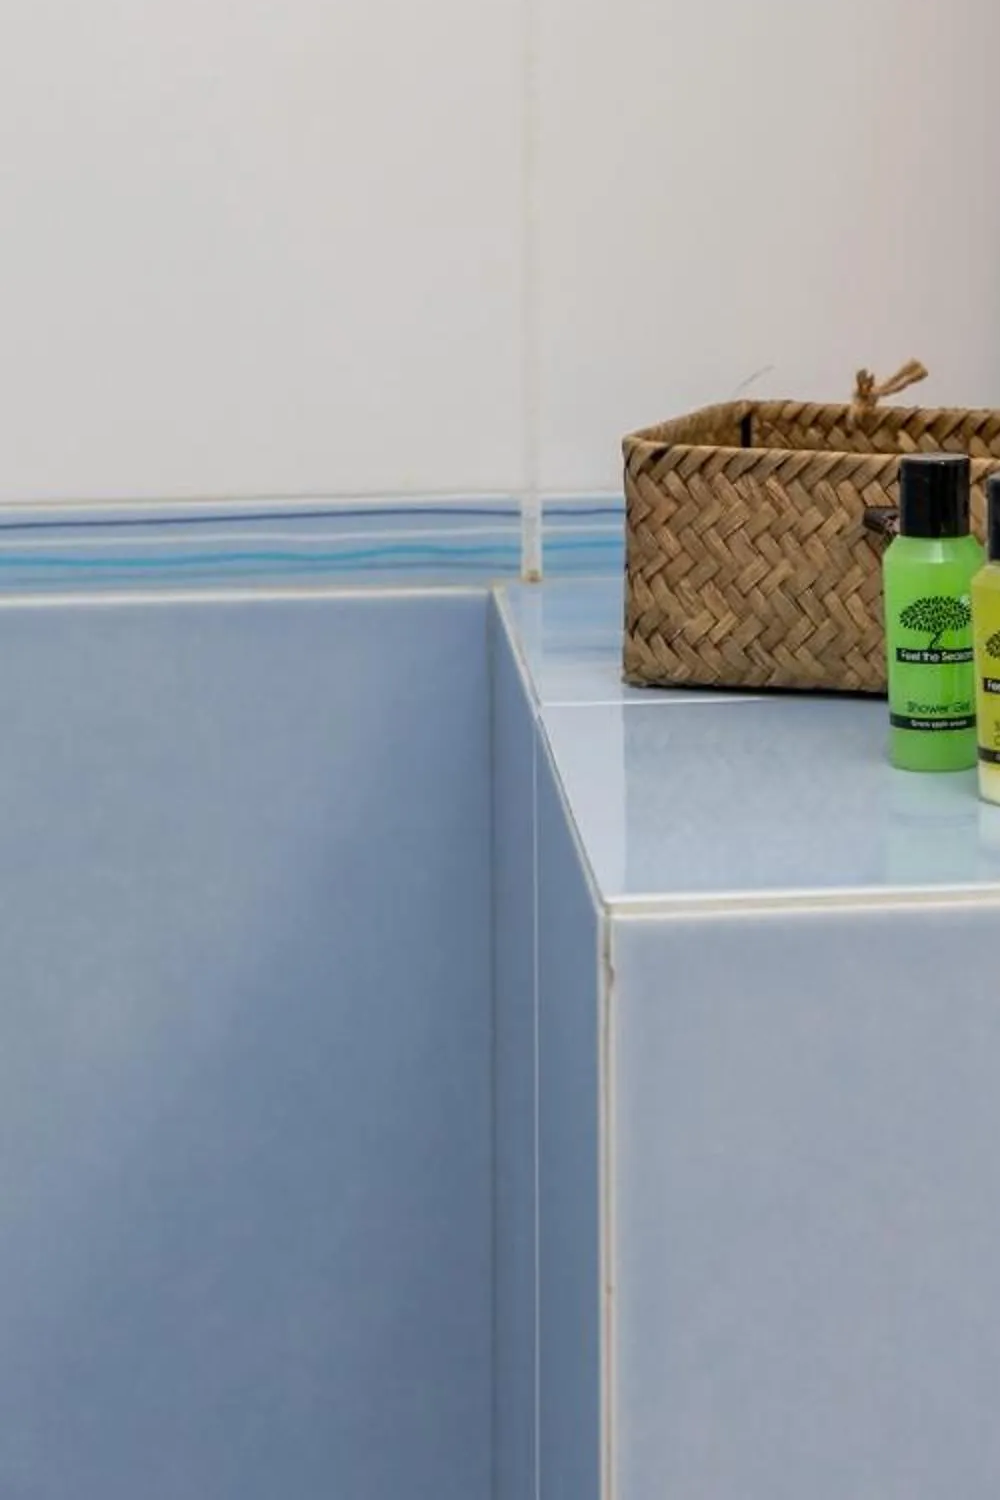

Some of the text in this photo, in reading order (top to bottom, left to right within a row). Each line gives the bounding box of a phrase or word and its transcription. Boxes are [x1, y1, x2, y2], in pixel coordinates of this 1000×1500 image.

[900, 648, 974, 662] Feel the Season
[907, 700, 949, 715] Shower
